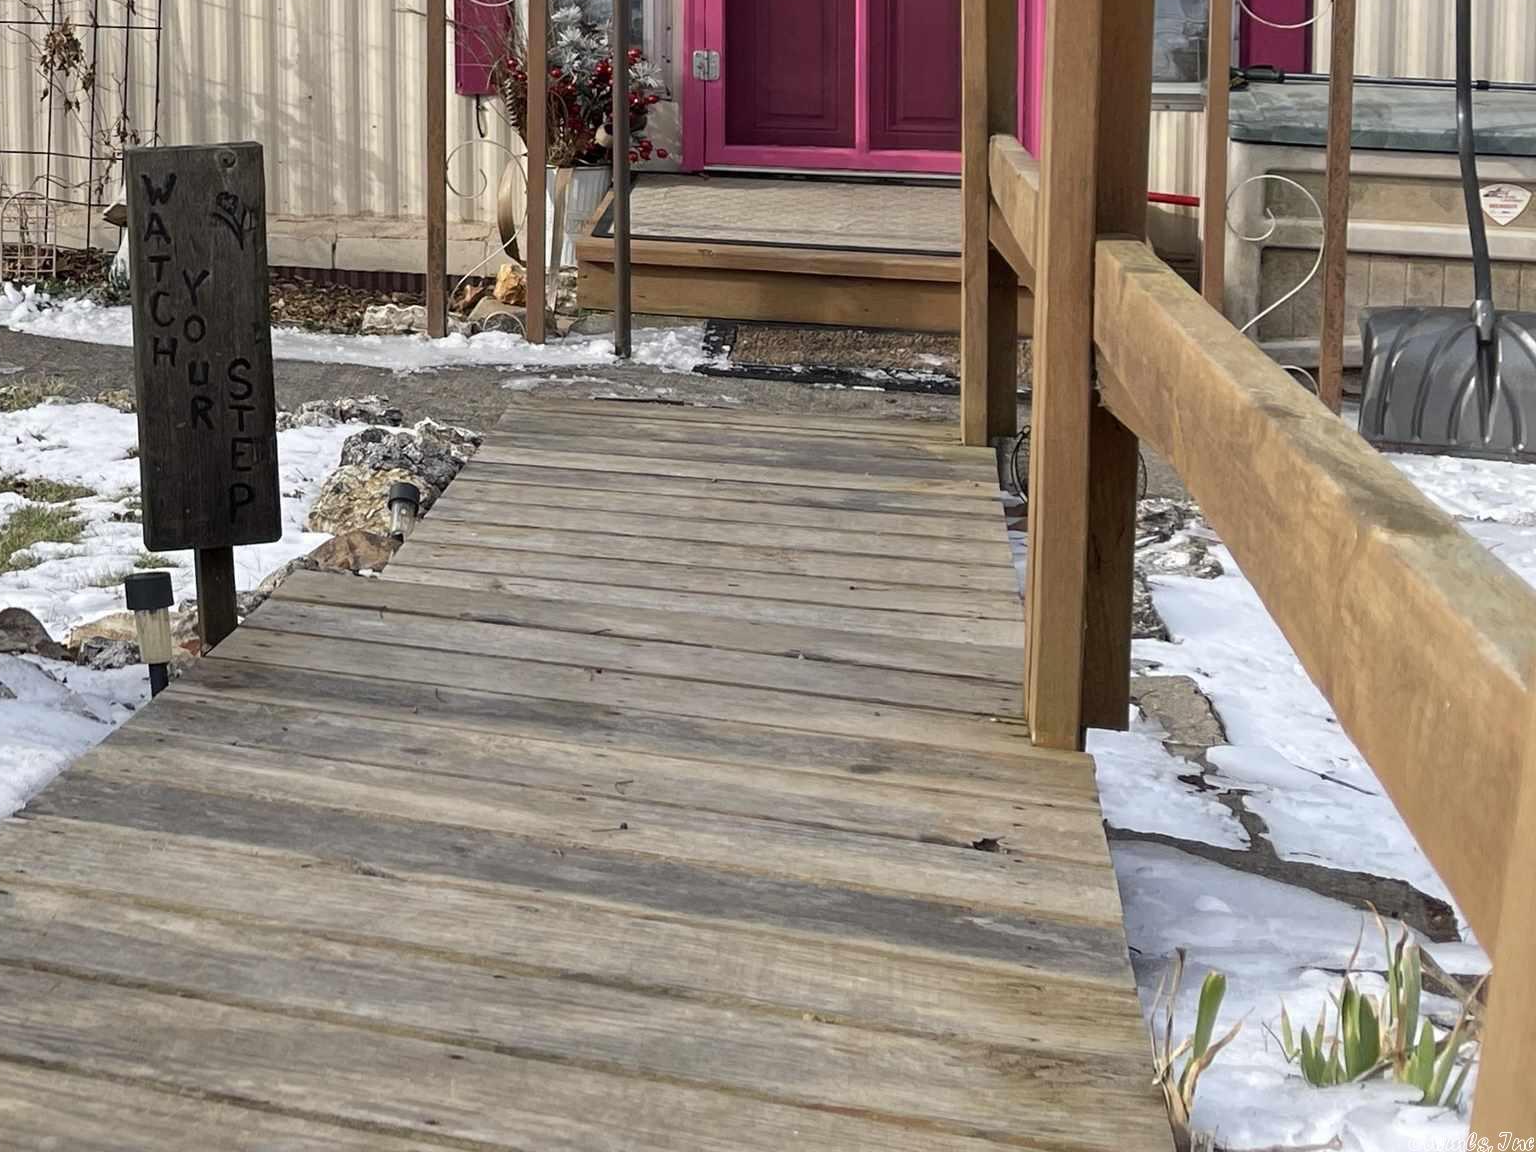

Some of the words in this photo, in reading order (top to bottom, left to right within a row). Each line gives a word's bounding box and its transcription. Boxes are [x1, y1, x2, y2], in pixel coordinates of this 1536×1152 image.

[141, 173, 178, 368] WATCH
[183, 269, 215, 430] YOUR
[227, 358, 255, 524] STEP
